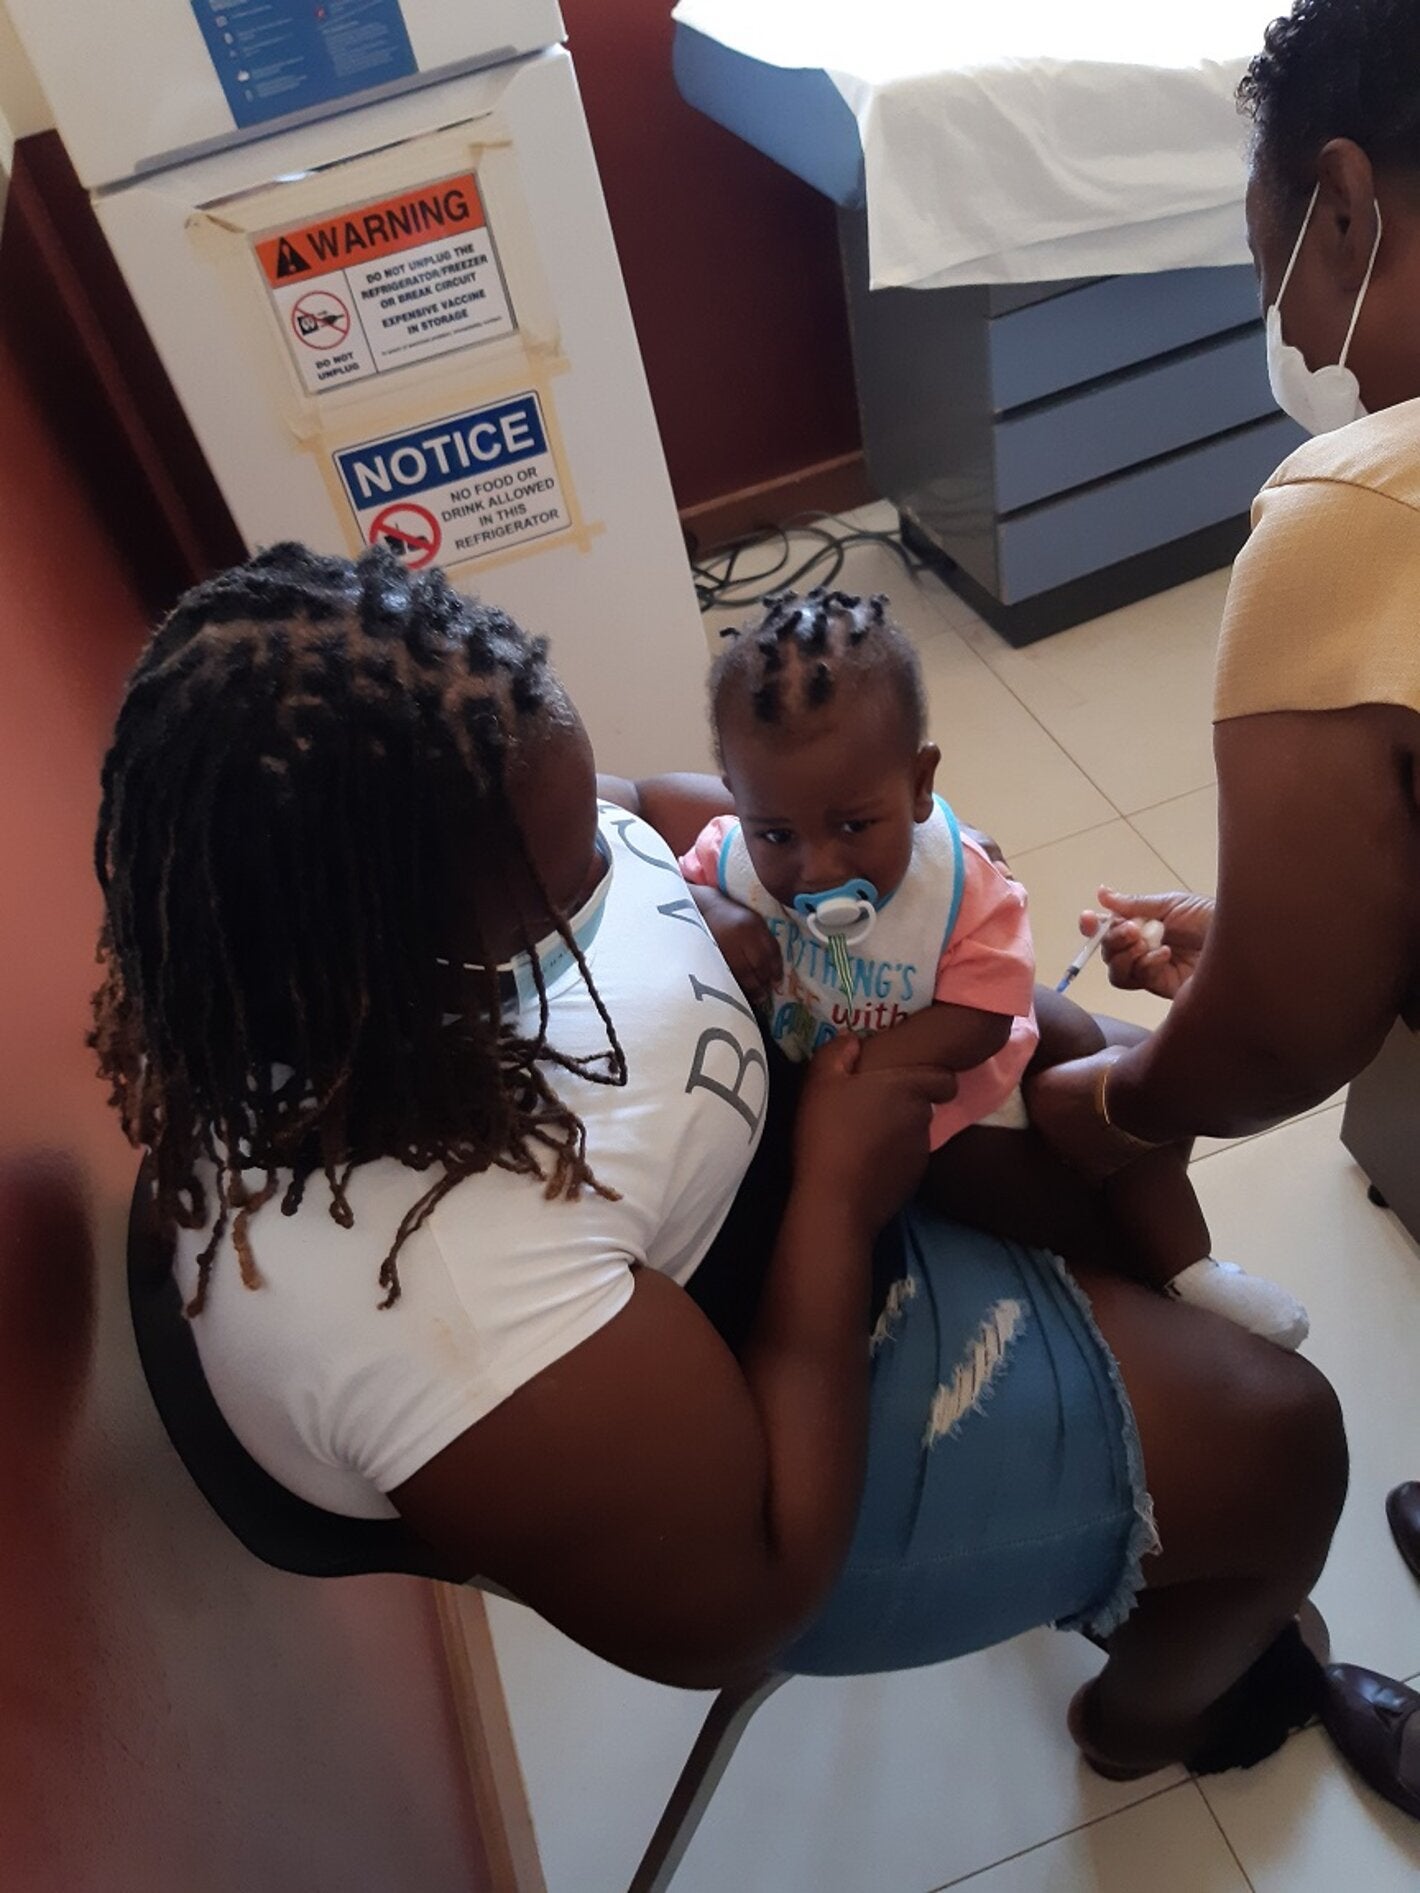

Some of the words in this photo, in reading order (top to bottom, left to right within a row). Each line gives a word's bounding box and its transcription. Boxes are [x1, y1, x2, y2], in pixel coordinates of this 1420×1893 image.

[307, 189, 471, 262] WARNING
[361, 254, 489, 300] REFRIGERATOR/FREEZER
[365, 271, 382, 284] DO
[384, 264, 406, 279] NOT
[408, 250, 452, 271] UNPLUG
[453, 243, 475, 257] THE
[380, 296, 396, 309] OR
[397, 286, 432, 304] BREAK
[434, 271, 477, 293] CIRCUIT
[381, 303, 439, 328] EXPENSIVE
[440, 288, 487, 310] VACCINE
[407, 323, 419, 335] IN
[420, 308, 469, 331] STORAGE
[315, 359, 331, 370] DO
[333, 351, 354, 364] NOT
[317, 362, 360, 380] UNPLUG
[352, 411, 536, 499] NOTICE
[441, 501, 485, 523] DRINK
[488, 477, 555, 510] ALLOWED
[450, 488, 472, 504] NO
[474, 473, 514, 497] FOOD
[516, 466, 538, 483] OR
[454, 508, 560, 551] REFRIGERATOR
[478, 514, 494, 528] IN
[498, 503, 528, 523] THIS
[831, 1002, 910, 1030] with
